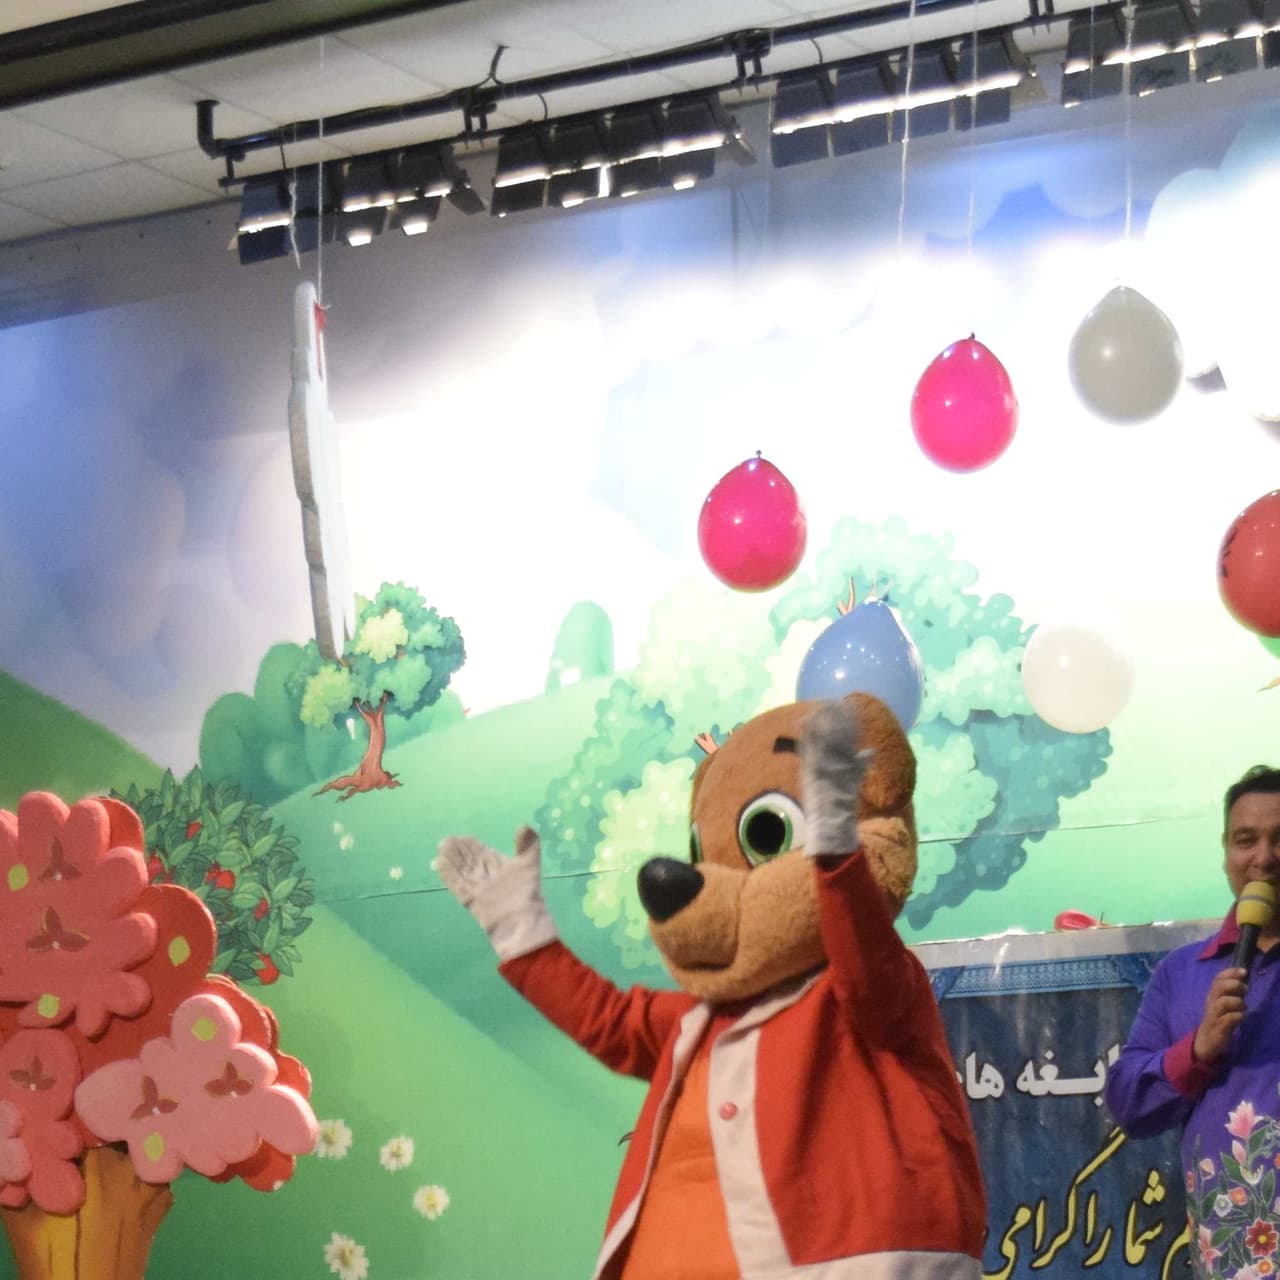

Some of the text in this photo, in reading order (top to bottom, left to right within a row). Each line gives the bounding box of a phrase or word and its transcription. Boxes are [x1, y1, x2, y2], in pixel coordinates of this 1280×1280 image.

[956, 1043, 1119, 1106] بغه ها
[1083, 1192, 1113, 1267] را
[1125, 1169, 1165, 1265] شما
